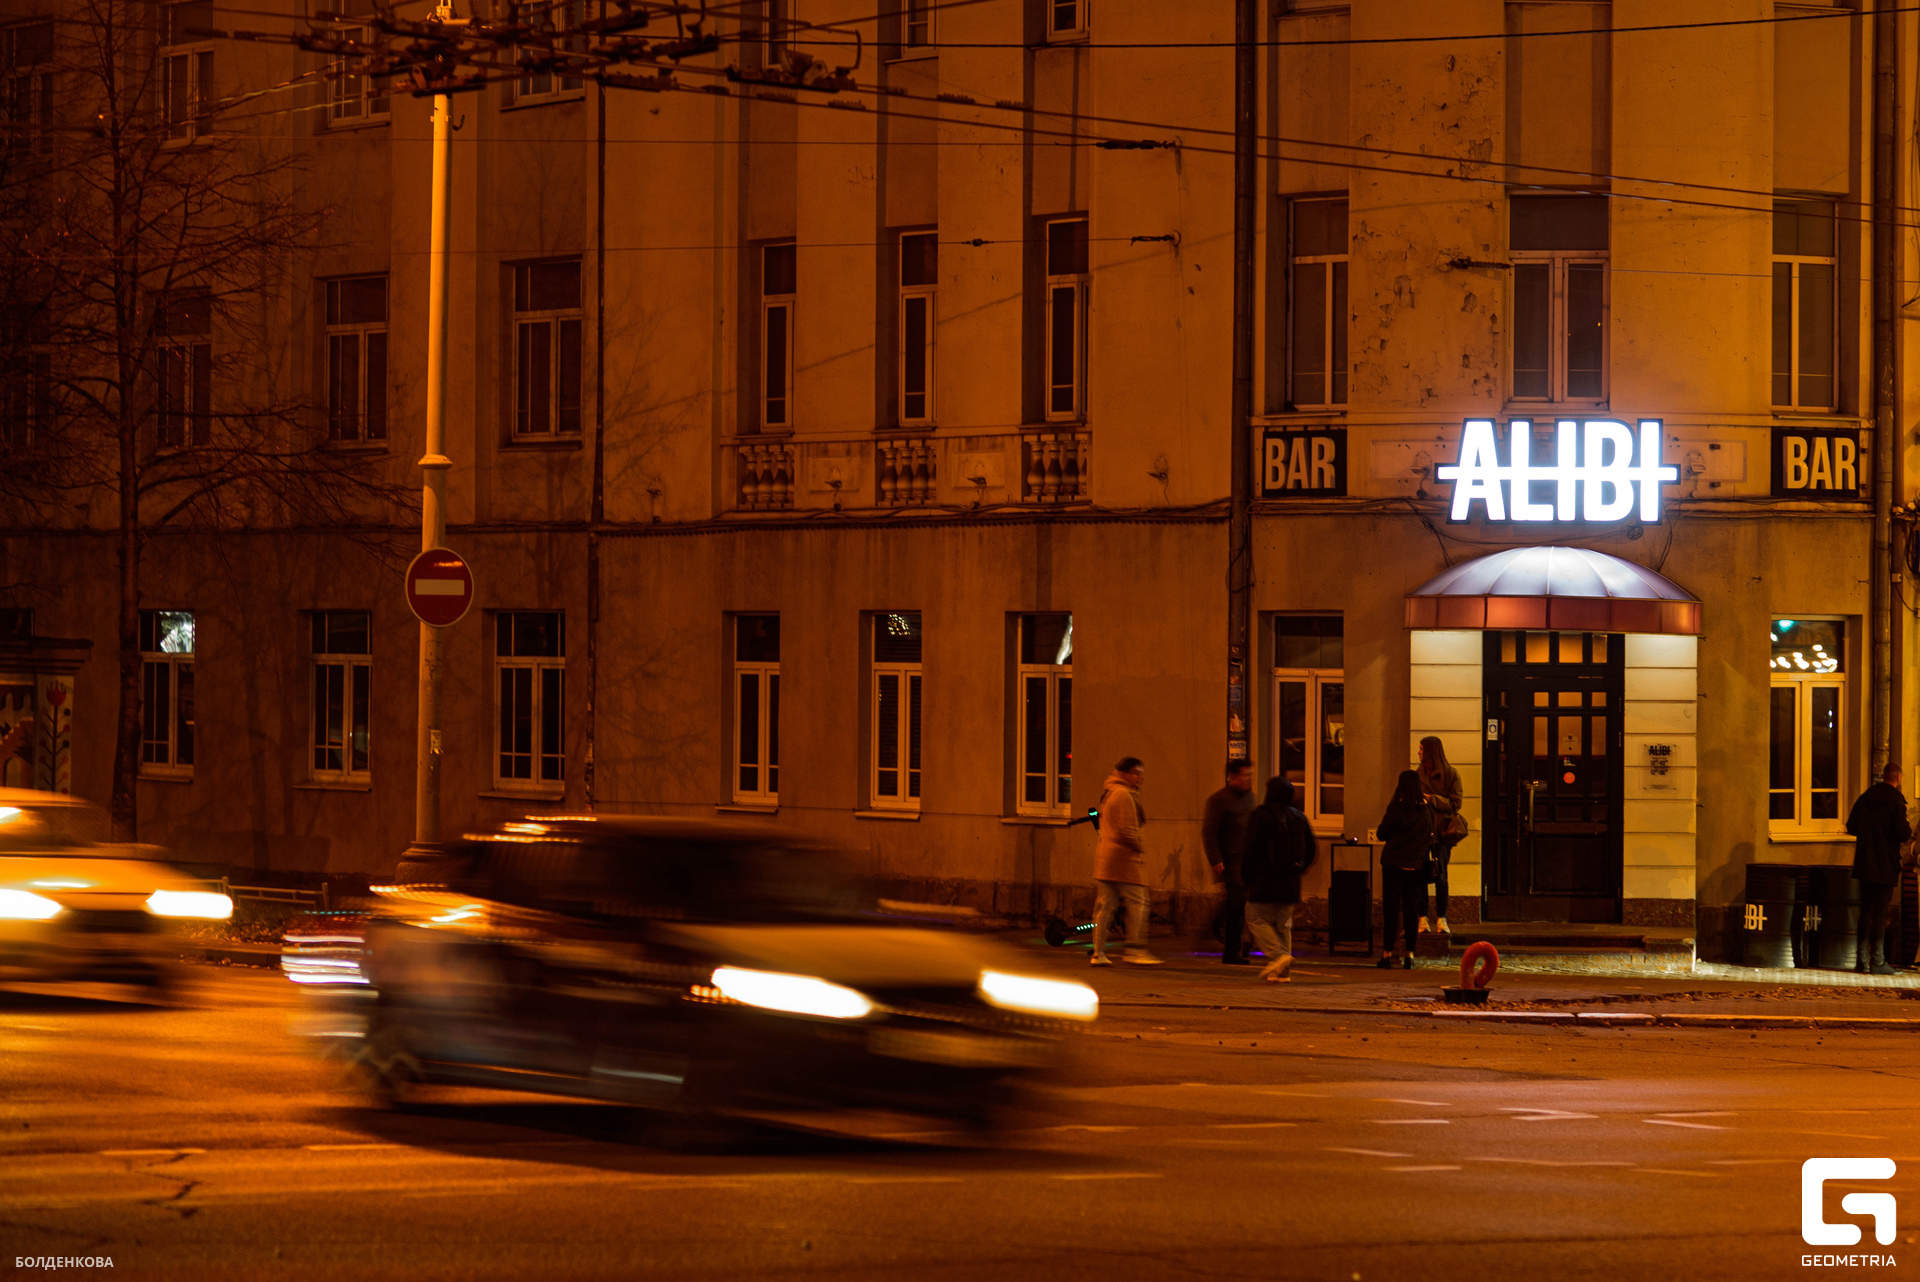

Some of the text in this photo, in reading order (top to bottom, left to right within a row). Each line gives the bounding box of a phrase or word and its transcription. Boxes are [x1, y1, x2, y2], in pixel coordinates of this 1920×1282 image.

[1265, 437, 1336, 490] BAR
[1437, 420, 1678, 522] ALIBI
[1783, 436, 1857, 490] BAR
[1648, 745, 1671, 756] ALIBI
